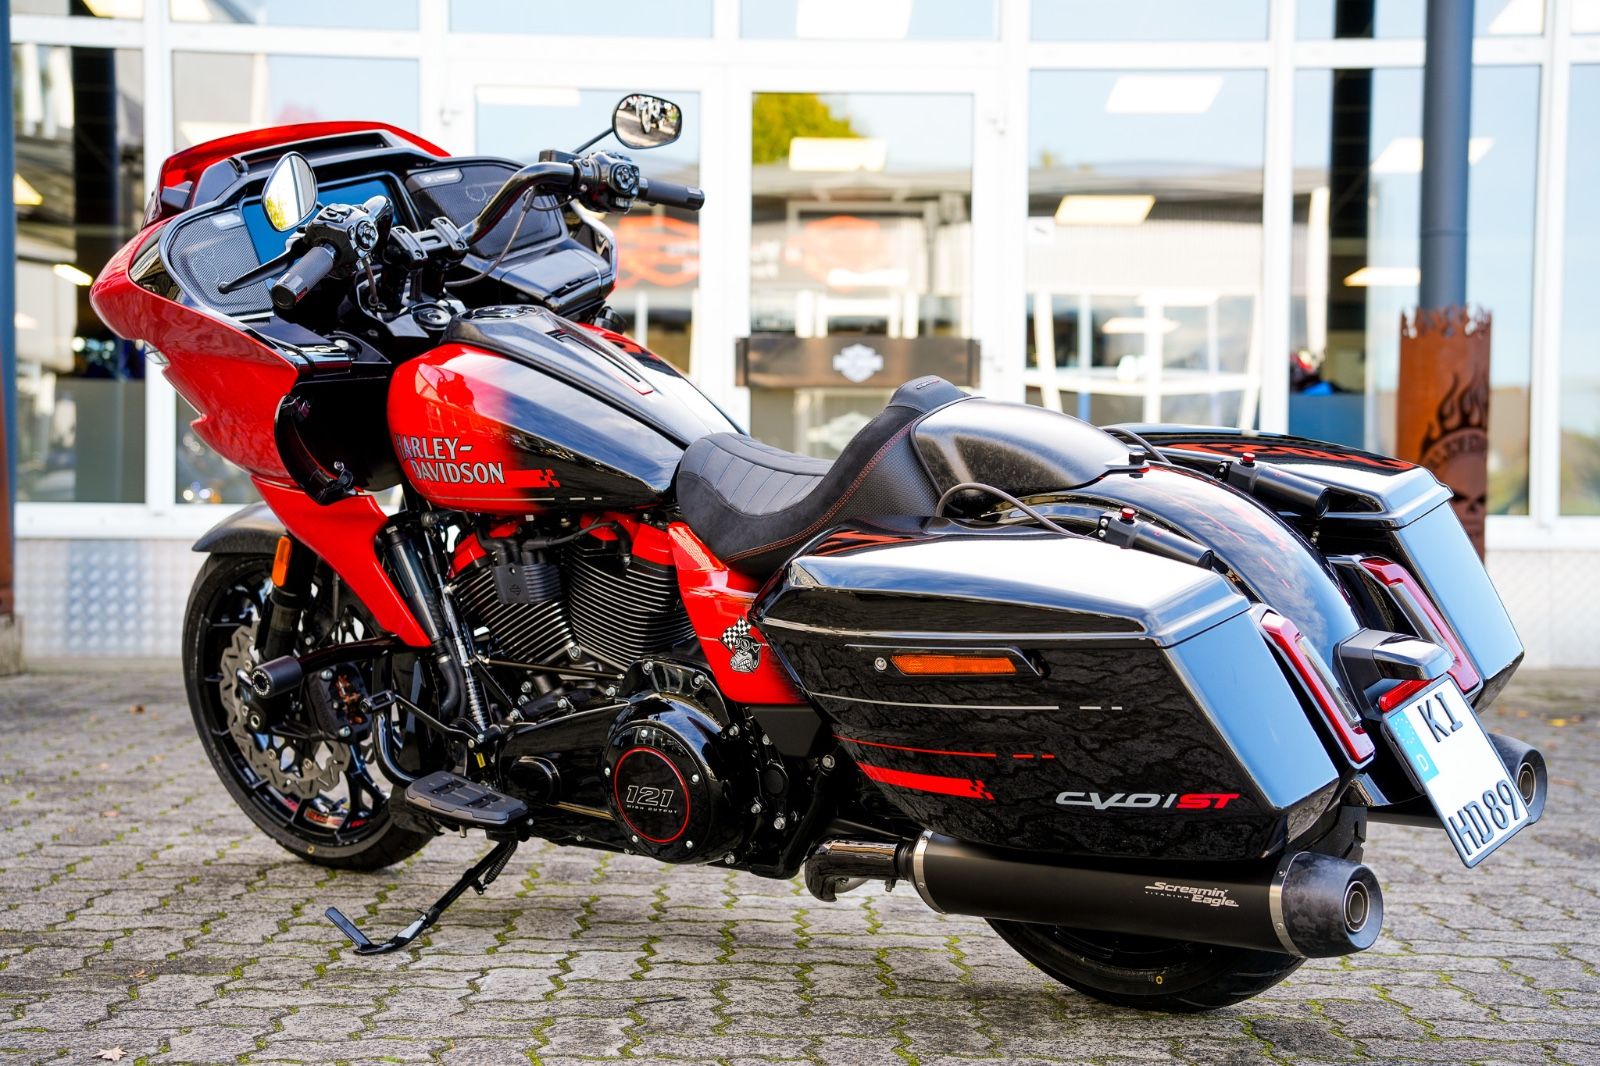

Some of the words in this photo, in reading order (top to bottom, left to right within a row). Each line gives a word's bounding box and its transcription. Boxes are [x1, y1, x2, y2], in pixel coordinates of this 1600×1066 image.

[411, 459, 505, 484] DAVIDSON
[1417, 691, 1464, 743] KI
[1416, 753, 1430, 772] D
[626, 784, 674, 808] 121
[1191, 893, 1239, 907] Eagle
